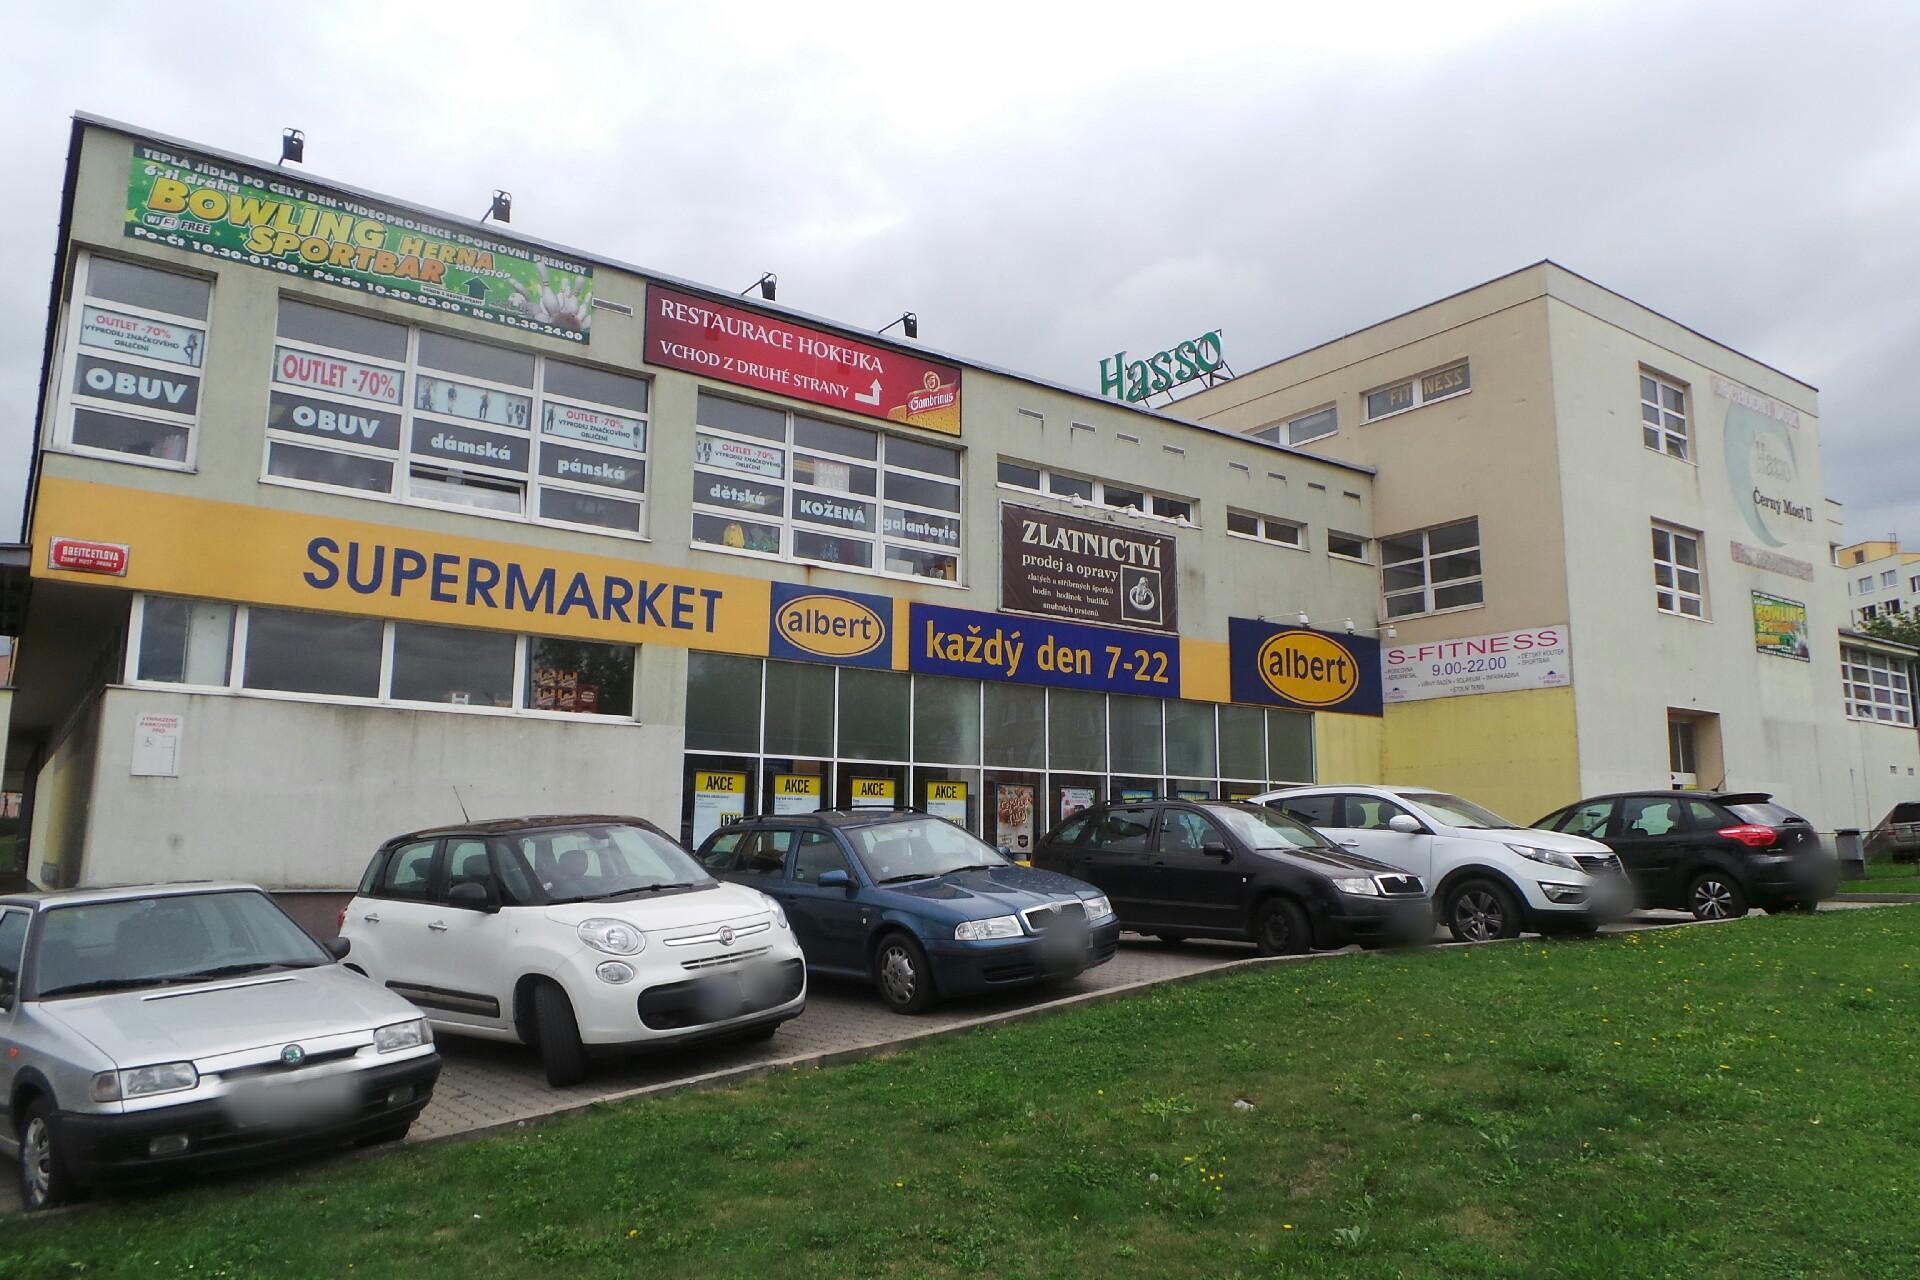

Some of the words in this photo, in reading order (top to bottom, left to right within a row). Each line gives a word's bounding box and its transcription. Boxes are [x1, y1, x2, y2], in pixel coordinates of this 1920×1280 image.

[184, 173, 240, 194] dráha
[242, 175, 264, 190] PO
[148, 177, 387, 248] BOWLING
[181, 221, 211, 234] FREE
[248, 226, 447, 284] SPORTBAR
[401, 235, 495, 271] HERNA
[134, 226, 186, 246] Po-Čt
[192, 240, 300, 274] 10.30-01.00
[313, 268, 361, 288] Pá-So
[367, 281, 461, 313] 10.30-03.00
[472, 307, 494, 322] Ne
[499, 313, 583, 342] 10.30-24.00
[95, 315, 138, 331] OUTLET
[141, 325, 171, 339] -70%
[660, 298, 793, 350] RESTAURACE
[798, 335, 885, 374] HOKEJKA
[282, 354, 347, 388] OUTLET
[352, 370, 395, 399] -70%
[659, 339, 720, 366] VCHOD
[723, 356, 735, 370] Z
[737, 359, 790, 384] DRUHÉ
[793, 374, 849, 398] STRANY
[1099, 331, 1224, 403] Hasso
[86, 367, 187, 404] OBUV
[910, 392, 954, 411] Gambrinus
[292, 405, 380, 439] OBUV
[566, 410, 598, 424] OUTLET
[601, 417, 624, 429] -70%
[430, 432, 512, 461] dámská
[722, 443, 751, 456] OUTLET
[557, 457, 626, 482] pánská
[709, 483, 766, 505] dětská
[1753, 486, 1781, 516] Černý
[1782, 499, 1805, 520] Most
[800, 499, 866, 524] KOŽENÁ
[883, 516, 958, 541] galanterie
[62, 546, 119, 561] BREITCETLOVA
[1022, 519, 1161, 568] ZLATNICTVÍ
[1022, 553, 1063, 574] prodej
[1065, 562, 1074, 573] a
[1076, 564, 1119, 582] opravy
[302, 536, 723, 634] SUPERMARKET
[1032, 586, 1052, 597] hodin
[1056, 590, 1082, 602] hodinek
[787, 606, 873, 641] albert
[926, 619, 1023, 678] každý
[1037, 635, 1092, 676] den
[1106, 645, 1170, 684] 7-22
[1387, 630, 1559, 665] S-FITNESS
[1267, 645, 1348, 686] albert
[1432, 656, 1507, 677] 9.00-22.00
[705, 775, 734, 791] AKCE
[784, 778, 810, 793] AKCE
[861, 782, 885, 796] AKCE
[935, 785, 957, 799] AKCE
